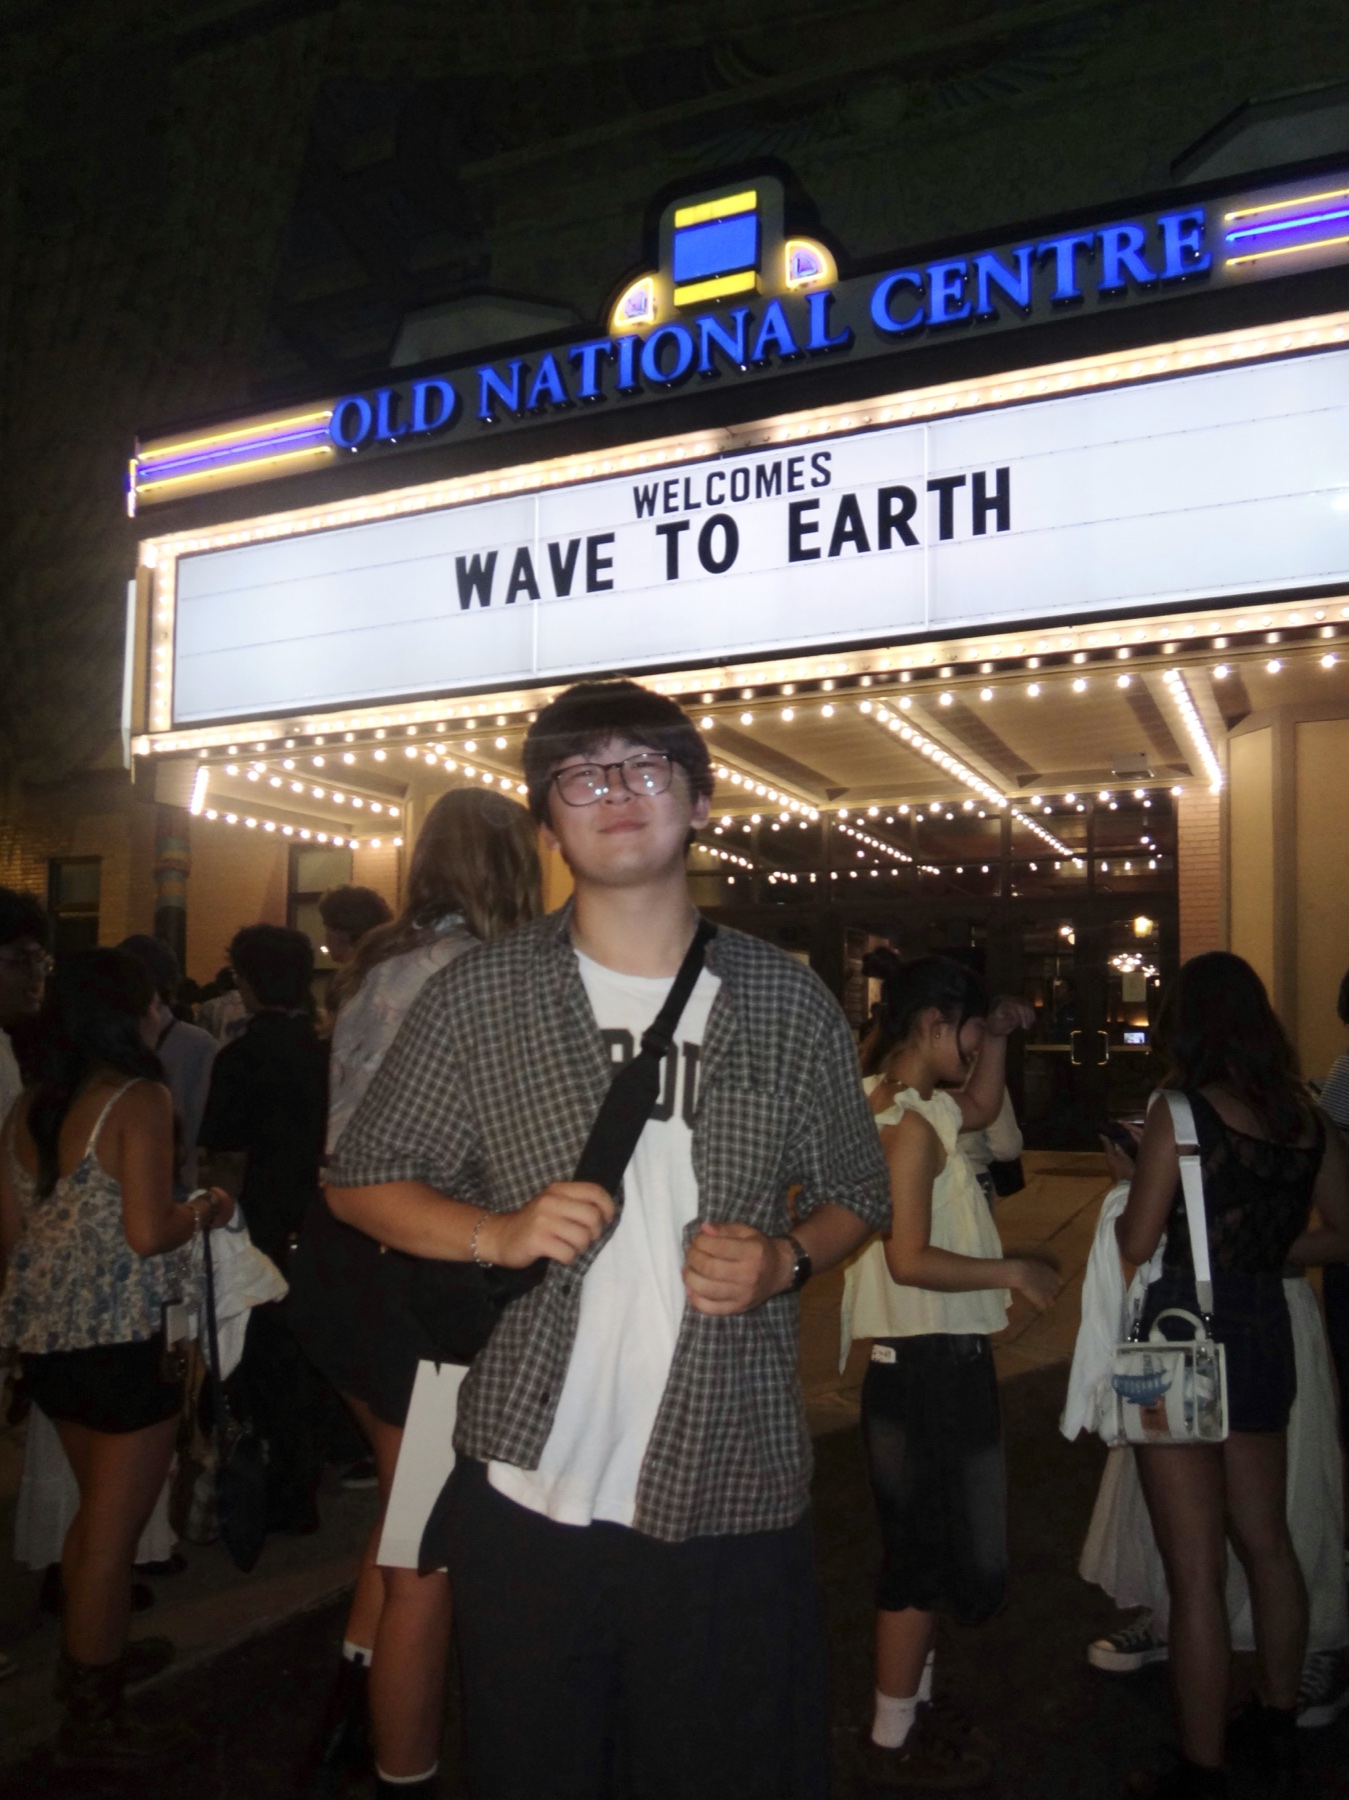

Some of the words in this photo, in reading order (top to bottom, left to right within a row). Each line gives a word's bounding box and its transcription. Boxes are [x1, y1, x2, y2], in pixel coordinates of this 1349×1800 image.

[328, 377, 457, 450] OLD
[475, 289, 850, 420] NATIONAL
[869, 206, 1215, 334] CENTRE
[455, 532, 616, 611] WAVE
[656, 513, 740, 581] TO
[787, 466, 1011, 564] EARTH
[632, 451, 833, 519] WELCOMES
